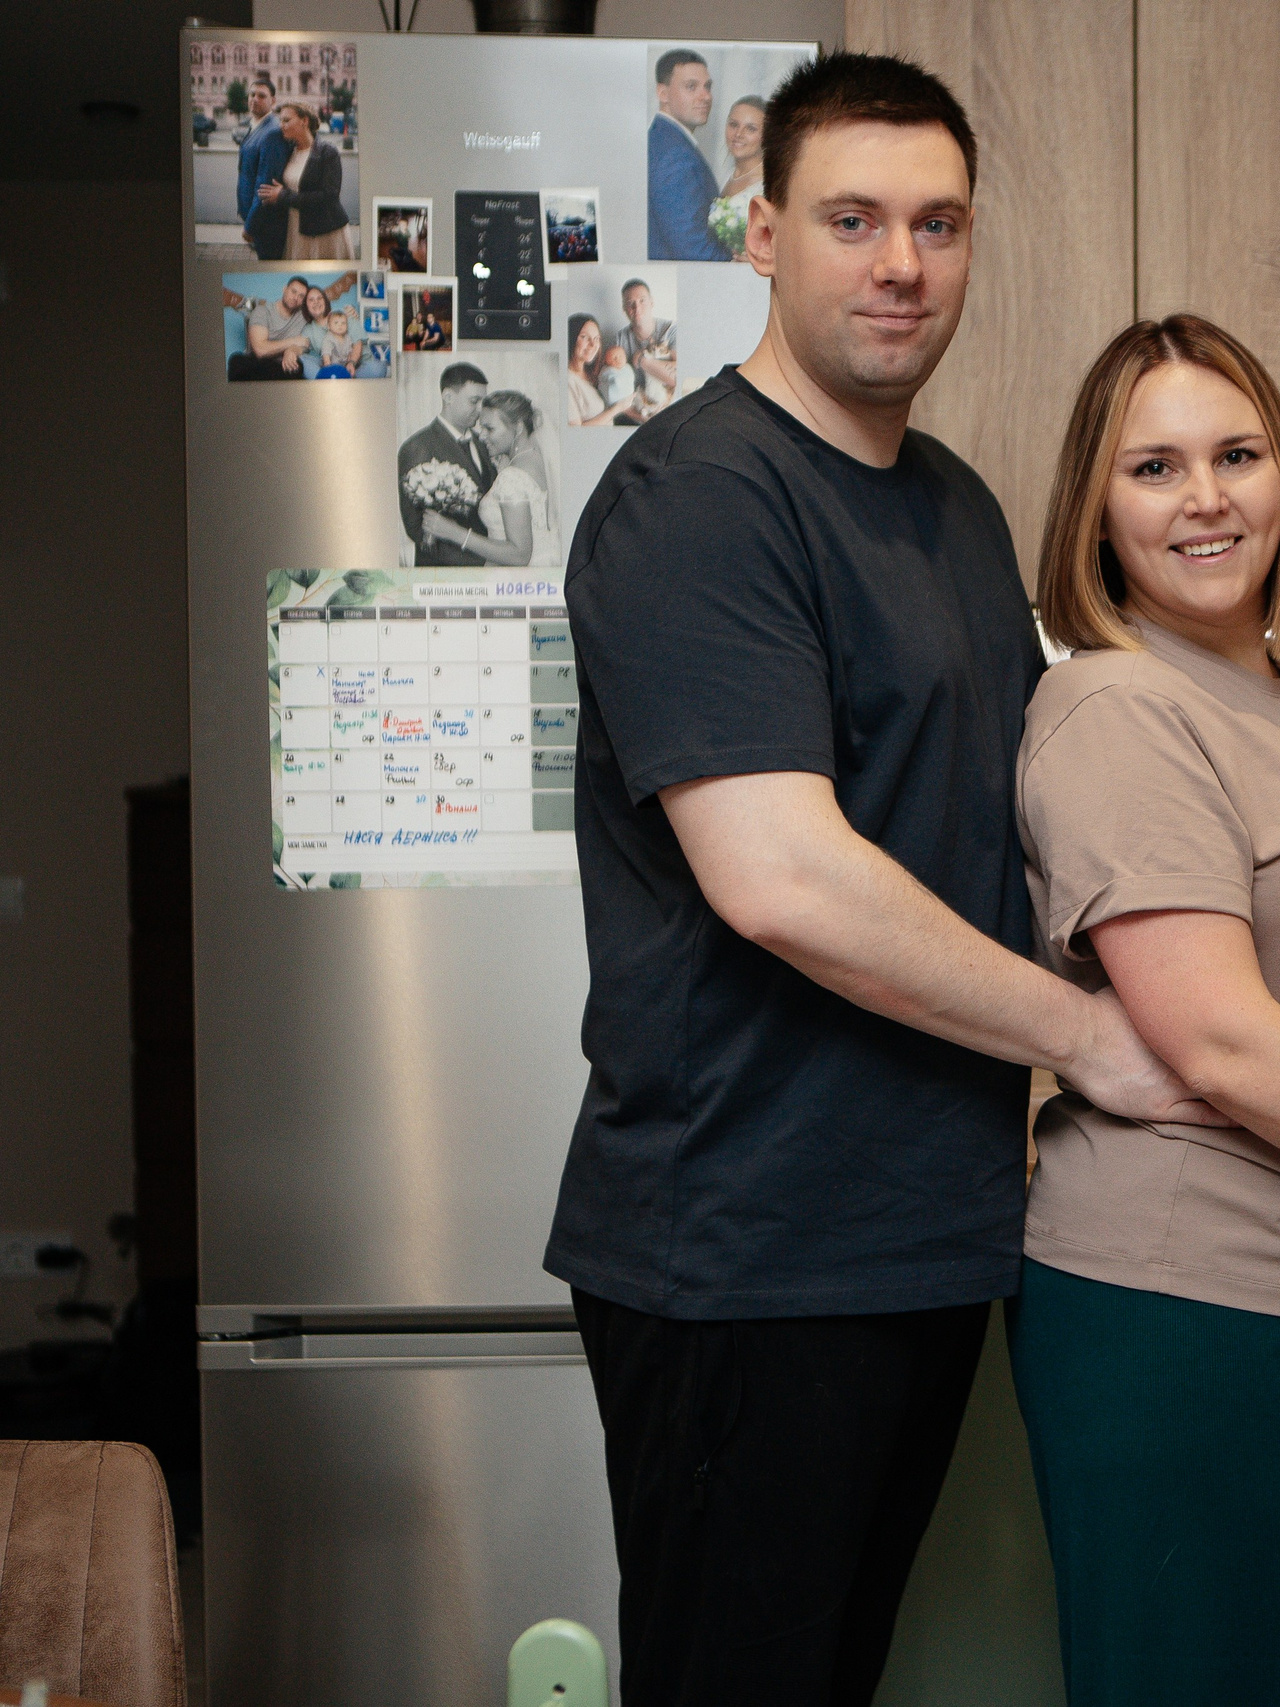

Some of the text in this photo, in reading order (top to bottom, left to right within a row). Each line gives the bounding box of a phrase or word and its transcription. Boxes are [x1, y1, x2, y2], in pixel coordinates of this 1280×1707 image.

[434, 588, 453, 597] ПЛАН
[454, 588, 464, 597] НА
[465, 588, 489, 597] МЕСЯЦ
[496, 582, 558, 596] НОЯБРЬ
[434, 667, 440, 676] 9
[484, 667, 492, 676] 10
[284, 711, 293, 720] 13
[334, 711, 341, 719] 14
[434, 710, 442, 719] 16
[483, 710, 491, 718] 17
[344, 830, 383, 846] НАСТЯ
[392, 828, 458, 847] ДЕРЖИСЬ
